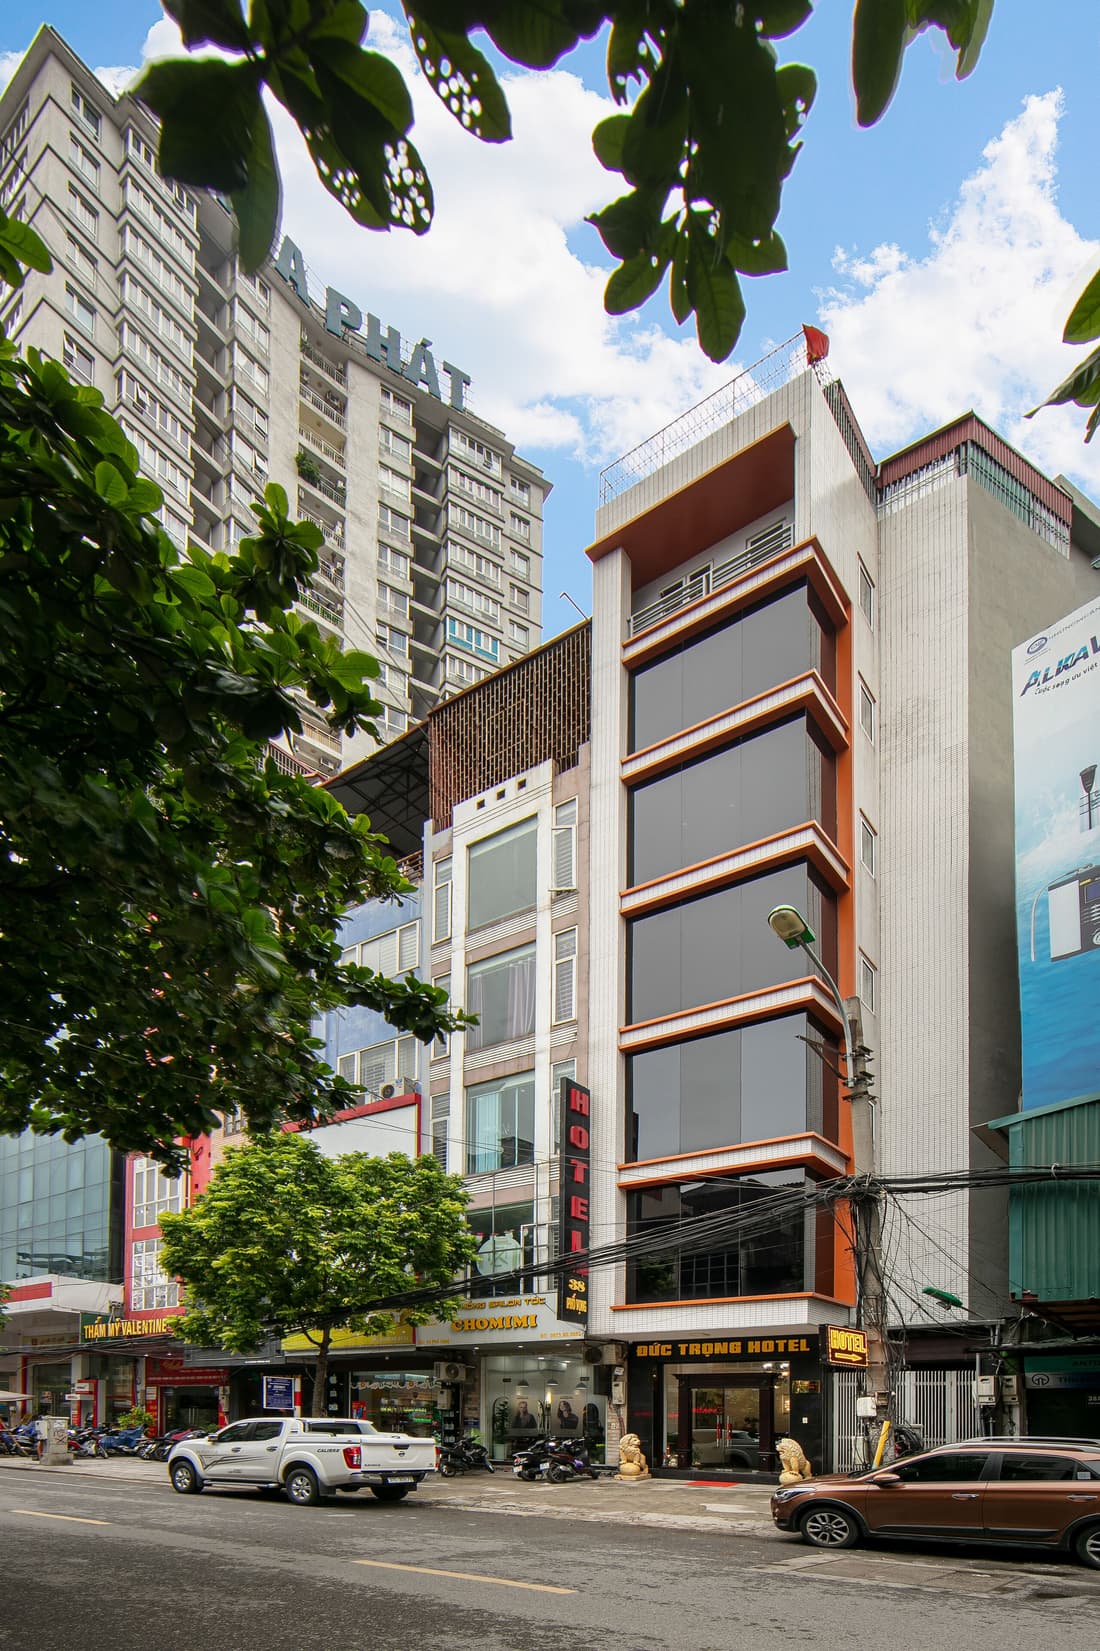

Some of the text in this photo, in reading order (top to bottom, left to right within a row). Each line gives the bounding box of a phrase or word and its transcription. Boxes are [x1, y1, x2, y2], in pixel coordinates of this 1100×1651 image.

[326, 286, 472, 412] PHÁT
[570, 1088, 589, 1277] HOTEL
[568, 1279, 586, 1292] 38
[489, 1299, 522, 1309] SALON
[525, 1295, 546, 1306] TÓC
[84, 1316, 167, 1339] THẨM MỸ VALENTINE
[450, 1314, 538, 1332] CHOMIMI
[636, 1339, 810, 1358] ĐỨC TRỌNG HOTEL
[830, 1329, 866, 1354] HOTEL
